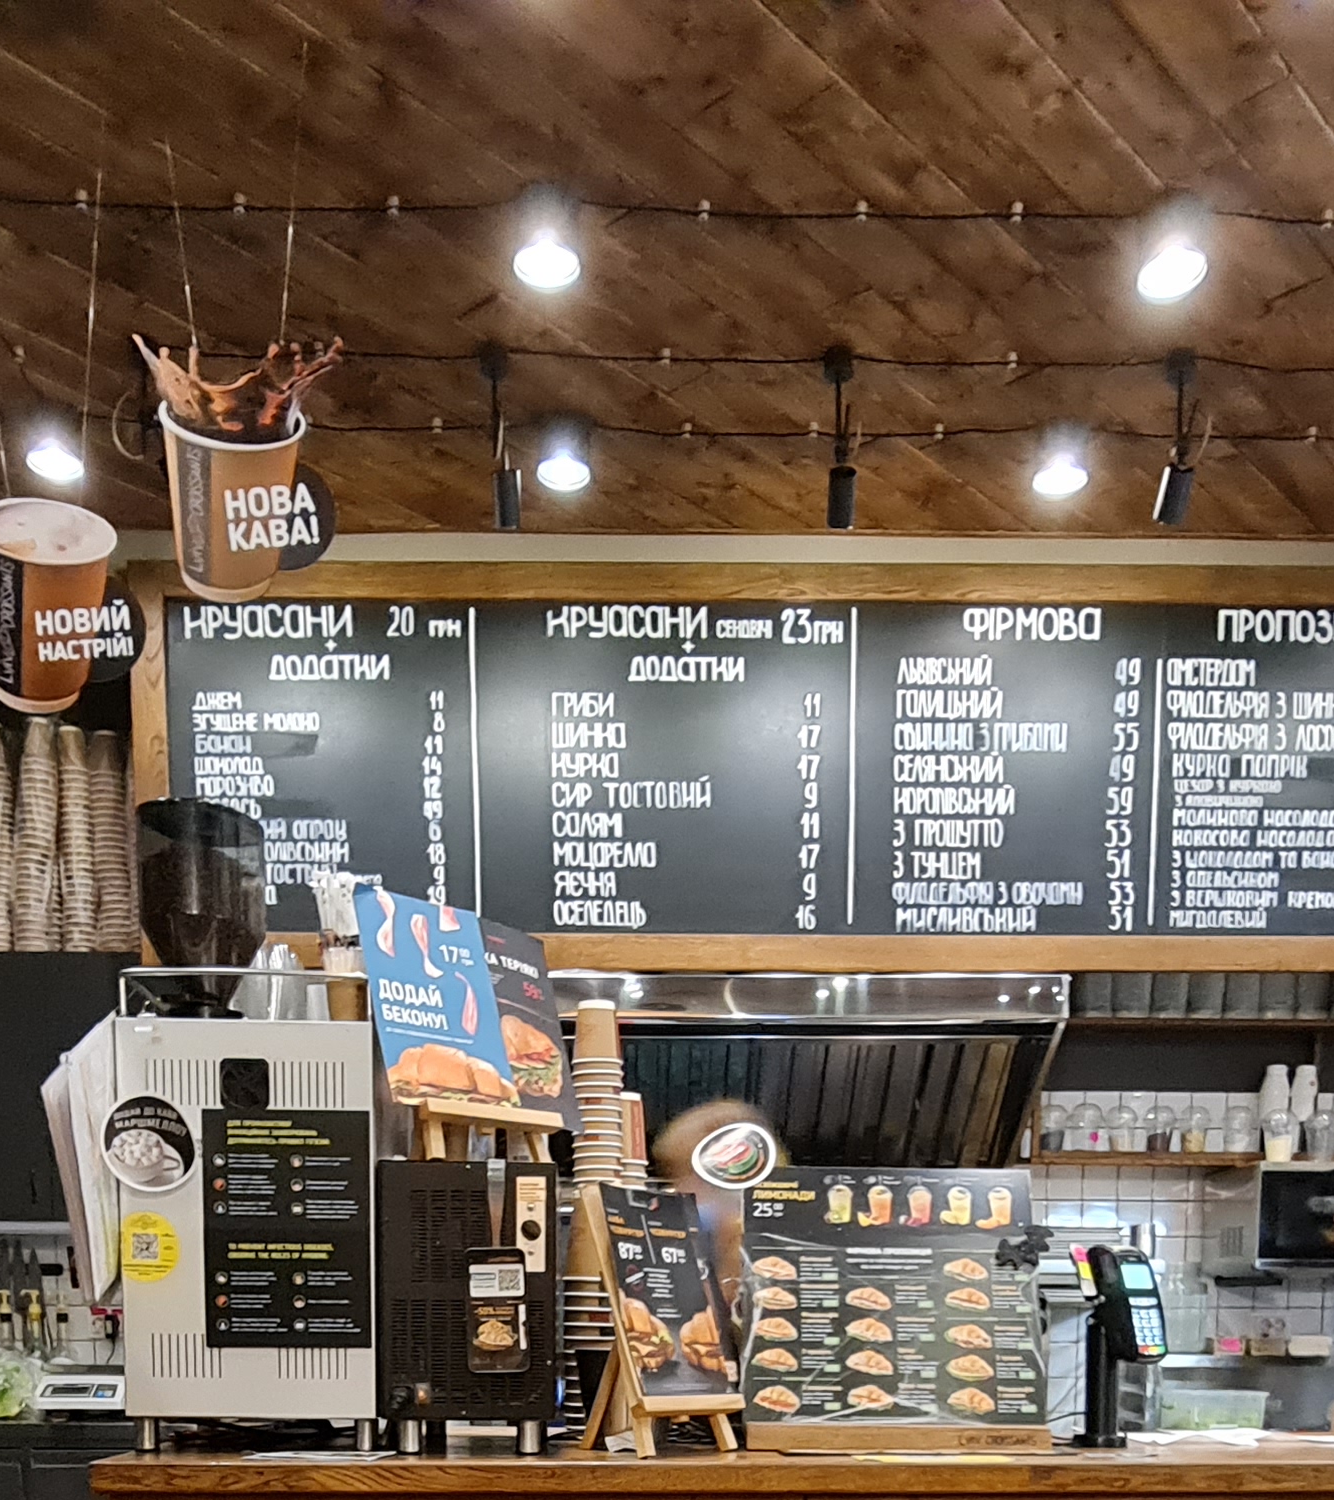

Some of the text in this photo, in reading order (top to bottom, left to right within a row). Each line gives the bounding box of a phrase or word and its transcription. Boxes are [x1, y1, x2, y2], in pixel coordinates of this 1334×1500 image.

[224, 482, 316, 520] НОВА
[227, 514, 320, 552] КАВА!
[35, 598, 131, 637] НОВИЙ
[183, 604, 353, 639] КРУАСАНИ
[386, 605, 415, 637] 20
[546, 605, 708, 639] КРУАСАНИ
[780, 608, 812, 644] 23
[963, 607, 1102, 641] ФІРМОВА
[38, 632, 134, 662] НАСТРІЙ!
[269, 654, 390, 680] ДОДАТКИ
[627, 655, 745, 682] ДОДАТКИ
[897, 654, 1141, 686] ЛЬВІВСЬКИЙ 49
[1166, 658, 1256, 687] АМСТЕРДАМ
[192, 690, 444, 711] ДЖЕМ 11
[551, 691, 821, 718] ГРИБИ 11
[895, 686, 1003, 720] ГАЛИЦЬКИЙ
[263, 711, 320, 732] МОЛОКО
[433, 712, 445, 732] 8
[551, 721, 821, 749] ШИНКА 17
[424, 735, 443, 754] 11
[1112, 722, 1140, 751] 55
[194, 756, 442, 776] ШОКОЛАД 14
[551, 752, 821, 780] КУРКА 17
[893, 751, 1004, 783] СЕЛЯНСЬКИЙ
[1172, 753, 1231, 778] КУРКА
[551, 775, 818, 809] СИР ТОСТОВИЙ 9
[1105, 787, 1133, 815] 59
[428, 820, 442, 841] 6
[552, 811, 820, 839] САЛЯМІ 11
[914, 818, 1003, 848] ПРОШУТТО
[1104, 819, 1132, 848] 53
[427, 843, 446, 865] 18
[798, 844, 820, 870] 17
[910, 851, 981, 880] ТУНЦЕМ
[1106, 850, 1130, 879] 51
[1278, 851, 1298, 869] ТА
[433, 865, 445, 885] 9
[554, 870, 817, 901] ЯЄЧНЯ 9
[1108, 881, 1135, 905] 53
[553, 900, 817, 930] ОСЕЛЕДЕЦЬ 16
[895, 905, 1133, 933] МИСЛИВСЬКИЙ 51
[439, 944, 459, 964] 17
[378, 978, 443, 1008] ДОДАЙ
[381, 1003, 448, 1030] БЕКОНУ!
[752, 1202, 773, 1217] 25
